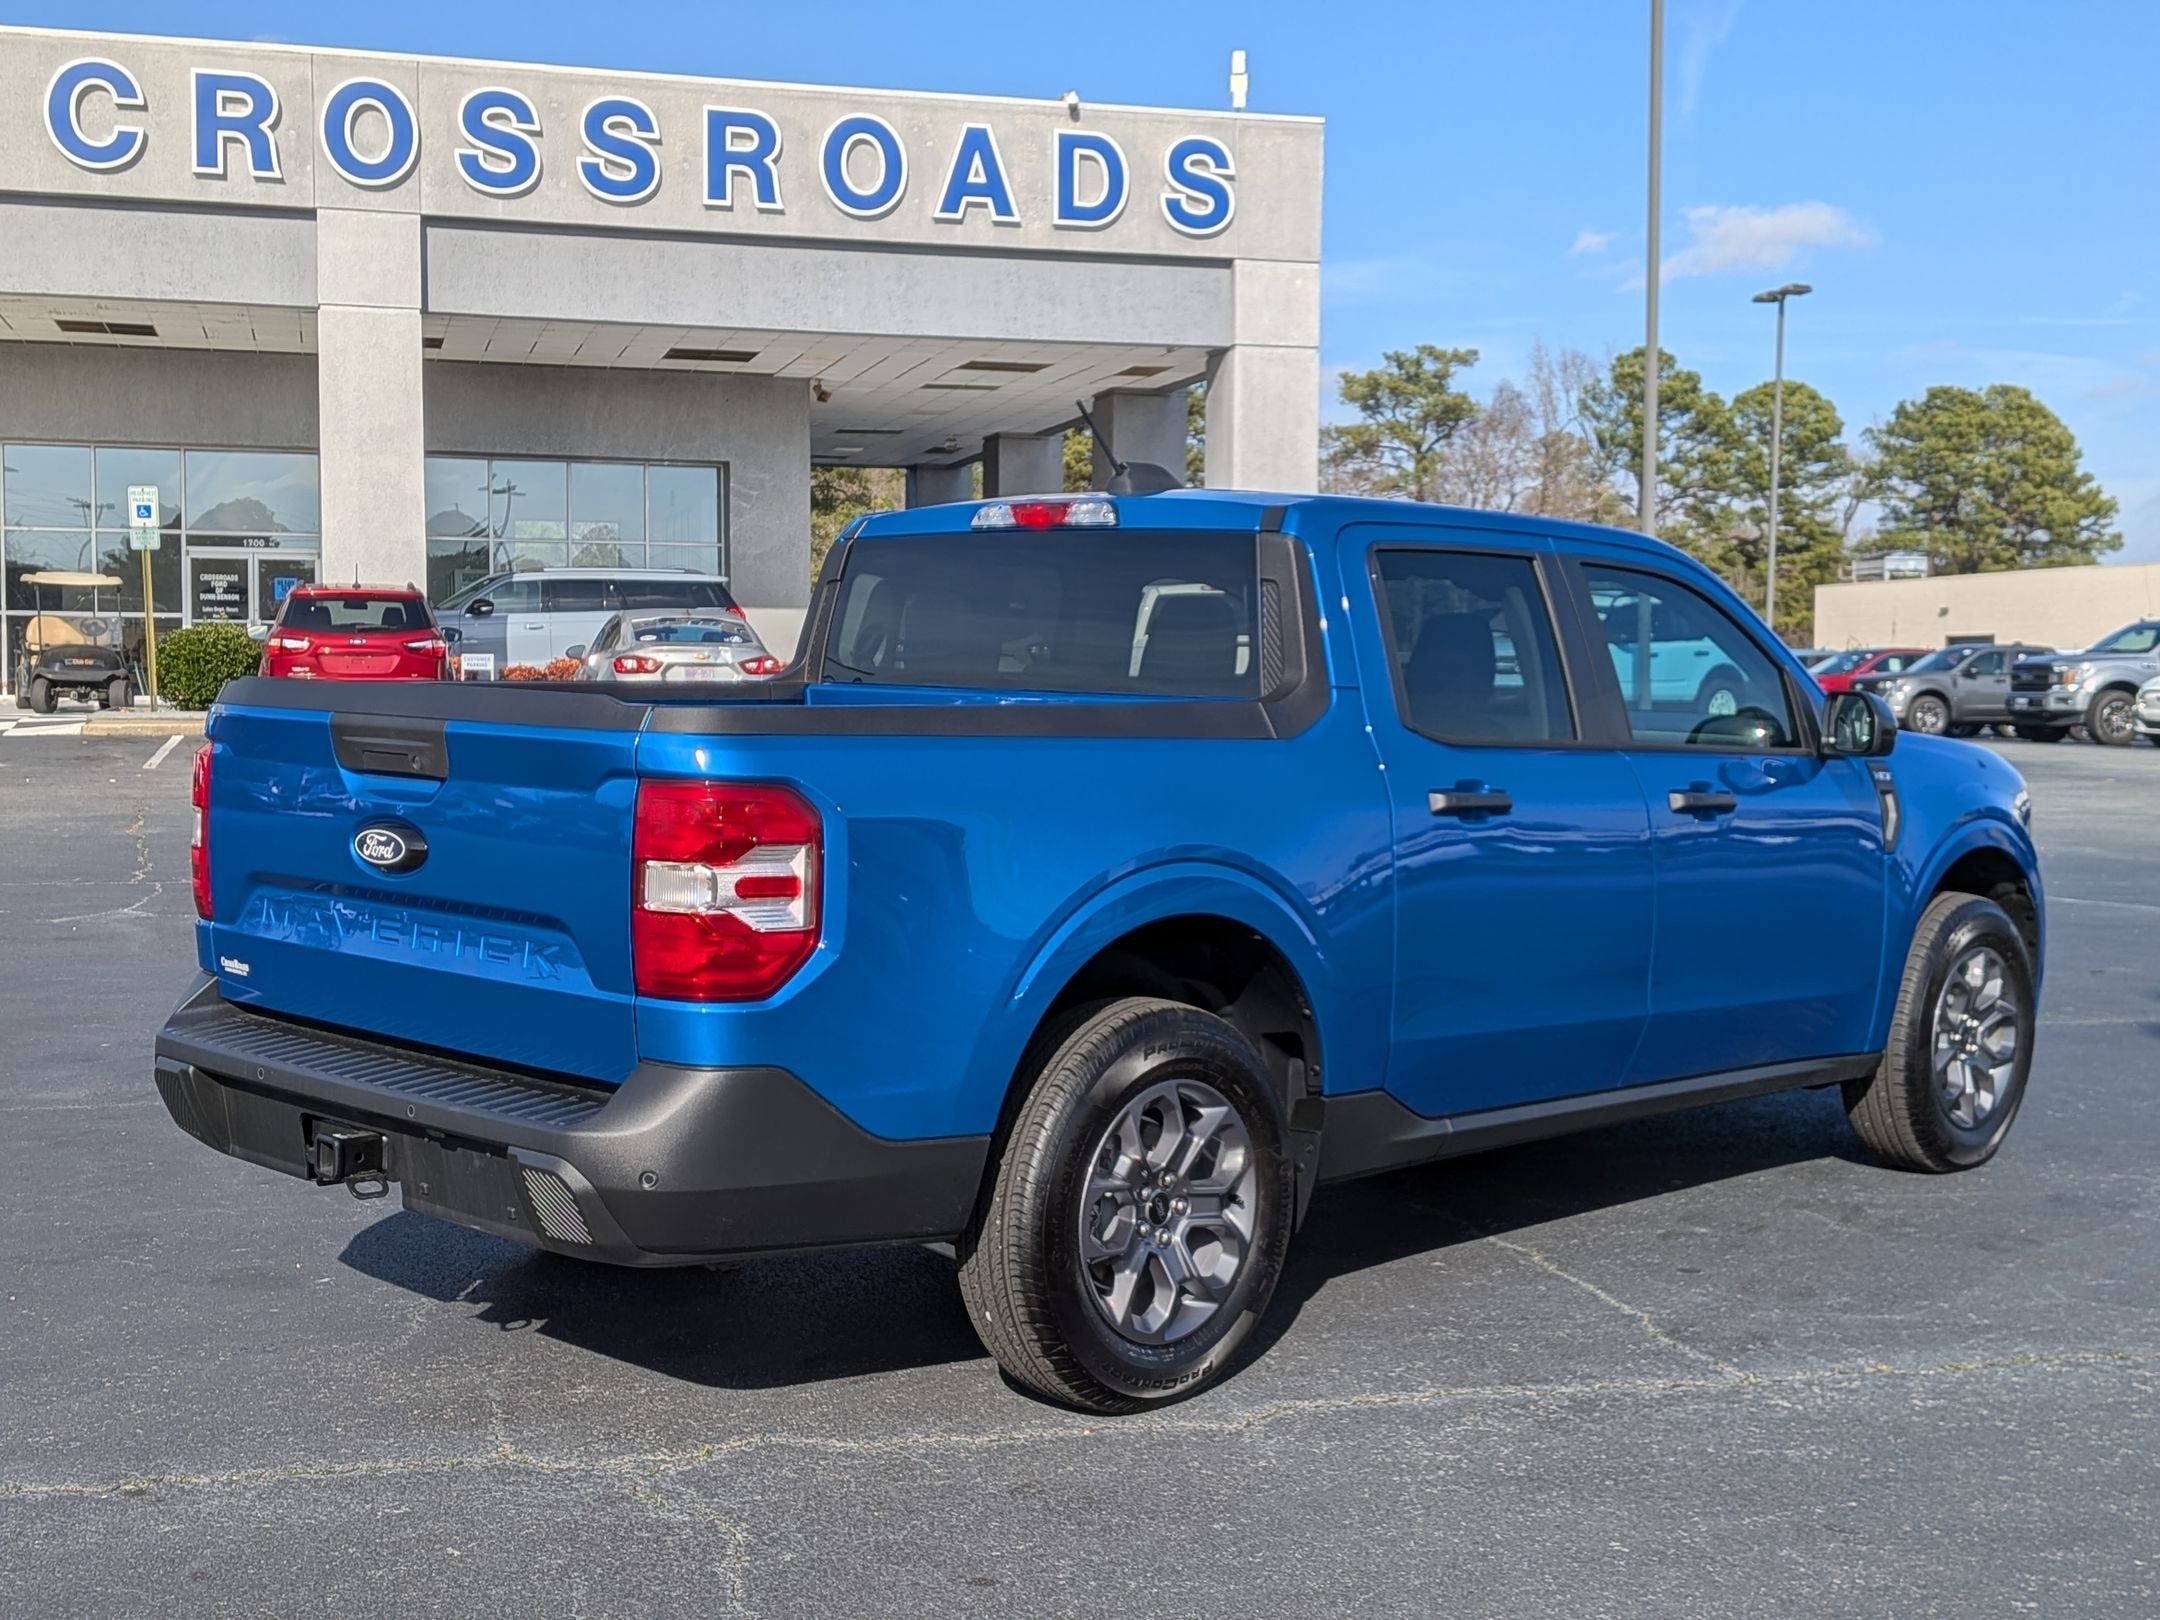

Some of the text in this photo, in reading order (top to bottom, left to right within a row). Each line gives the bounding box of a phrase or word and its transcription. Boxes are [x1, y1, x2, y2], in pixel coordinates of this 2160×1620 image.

[44, 57, 1236, 235] CROSSROADS
[243, 539, 265, 547] 1700
[200, 574, 239, 582] CROSSROADS
[362, 833, 395, 859] Ford
